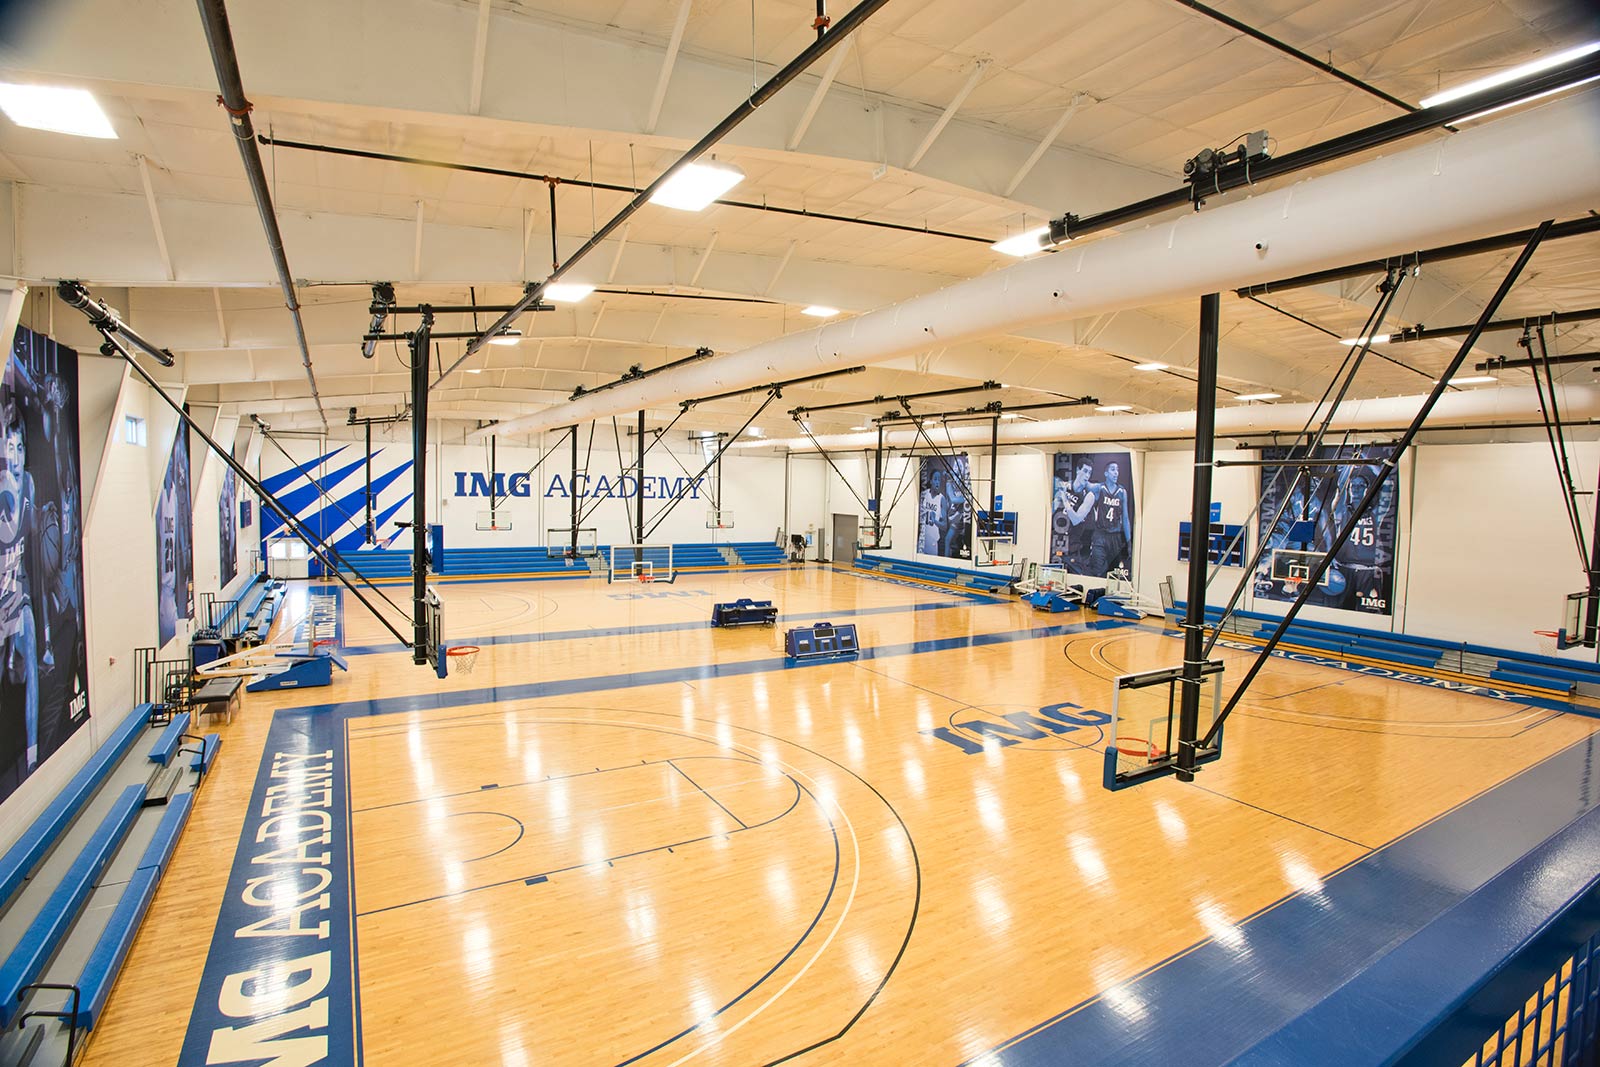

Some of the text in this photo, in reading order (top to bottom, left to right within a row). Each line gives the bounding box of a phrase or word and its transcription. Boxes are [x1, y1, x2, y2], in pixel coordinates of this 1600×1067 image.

[453, 471, 706, 500] IMG ACADEMY
[924, 501, 937, 511] IMG
[1103, 496, 1120, 506] IMG
[1374, 447, 1397, 578] PTENTIAL
[1106, 507, 1114, 522] 4
[1350, 527, 1374, 546] 45
[1360, 597, 1386, 609] IMG
[69, 690, 86, 719] IMG
[917, 702, 1126, 755] IMG
[234, 749, 334, 939] ACADEMY
